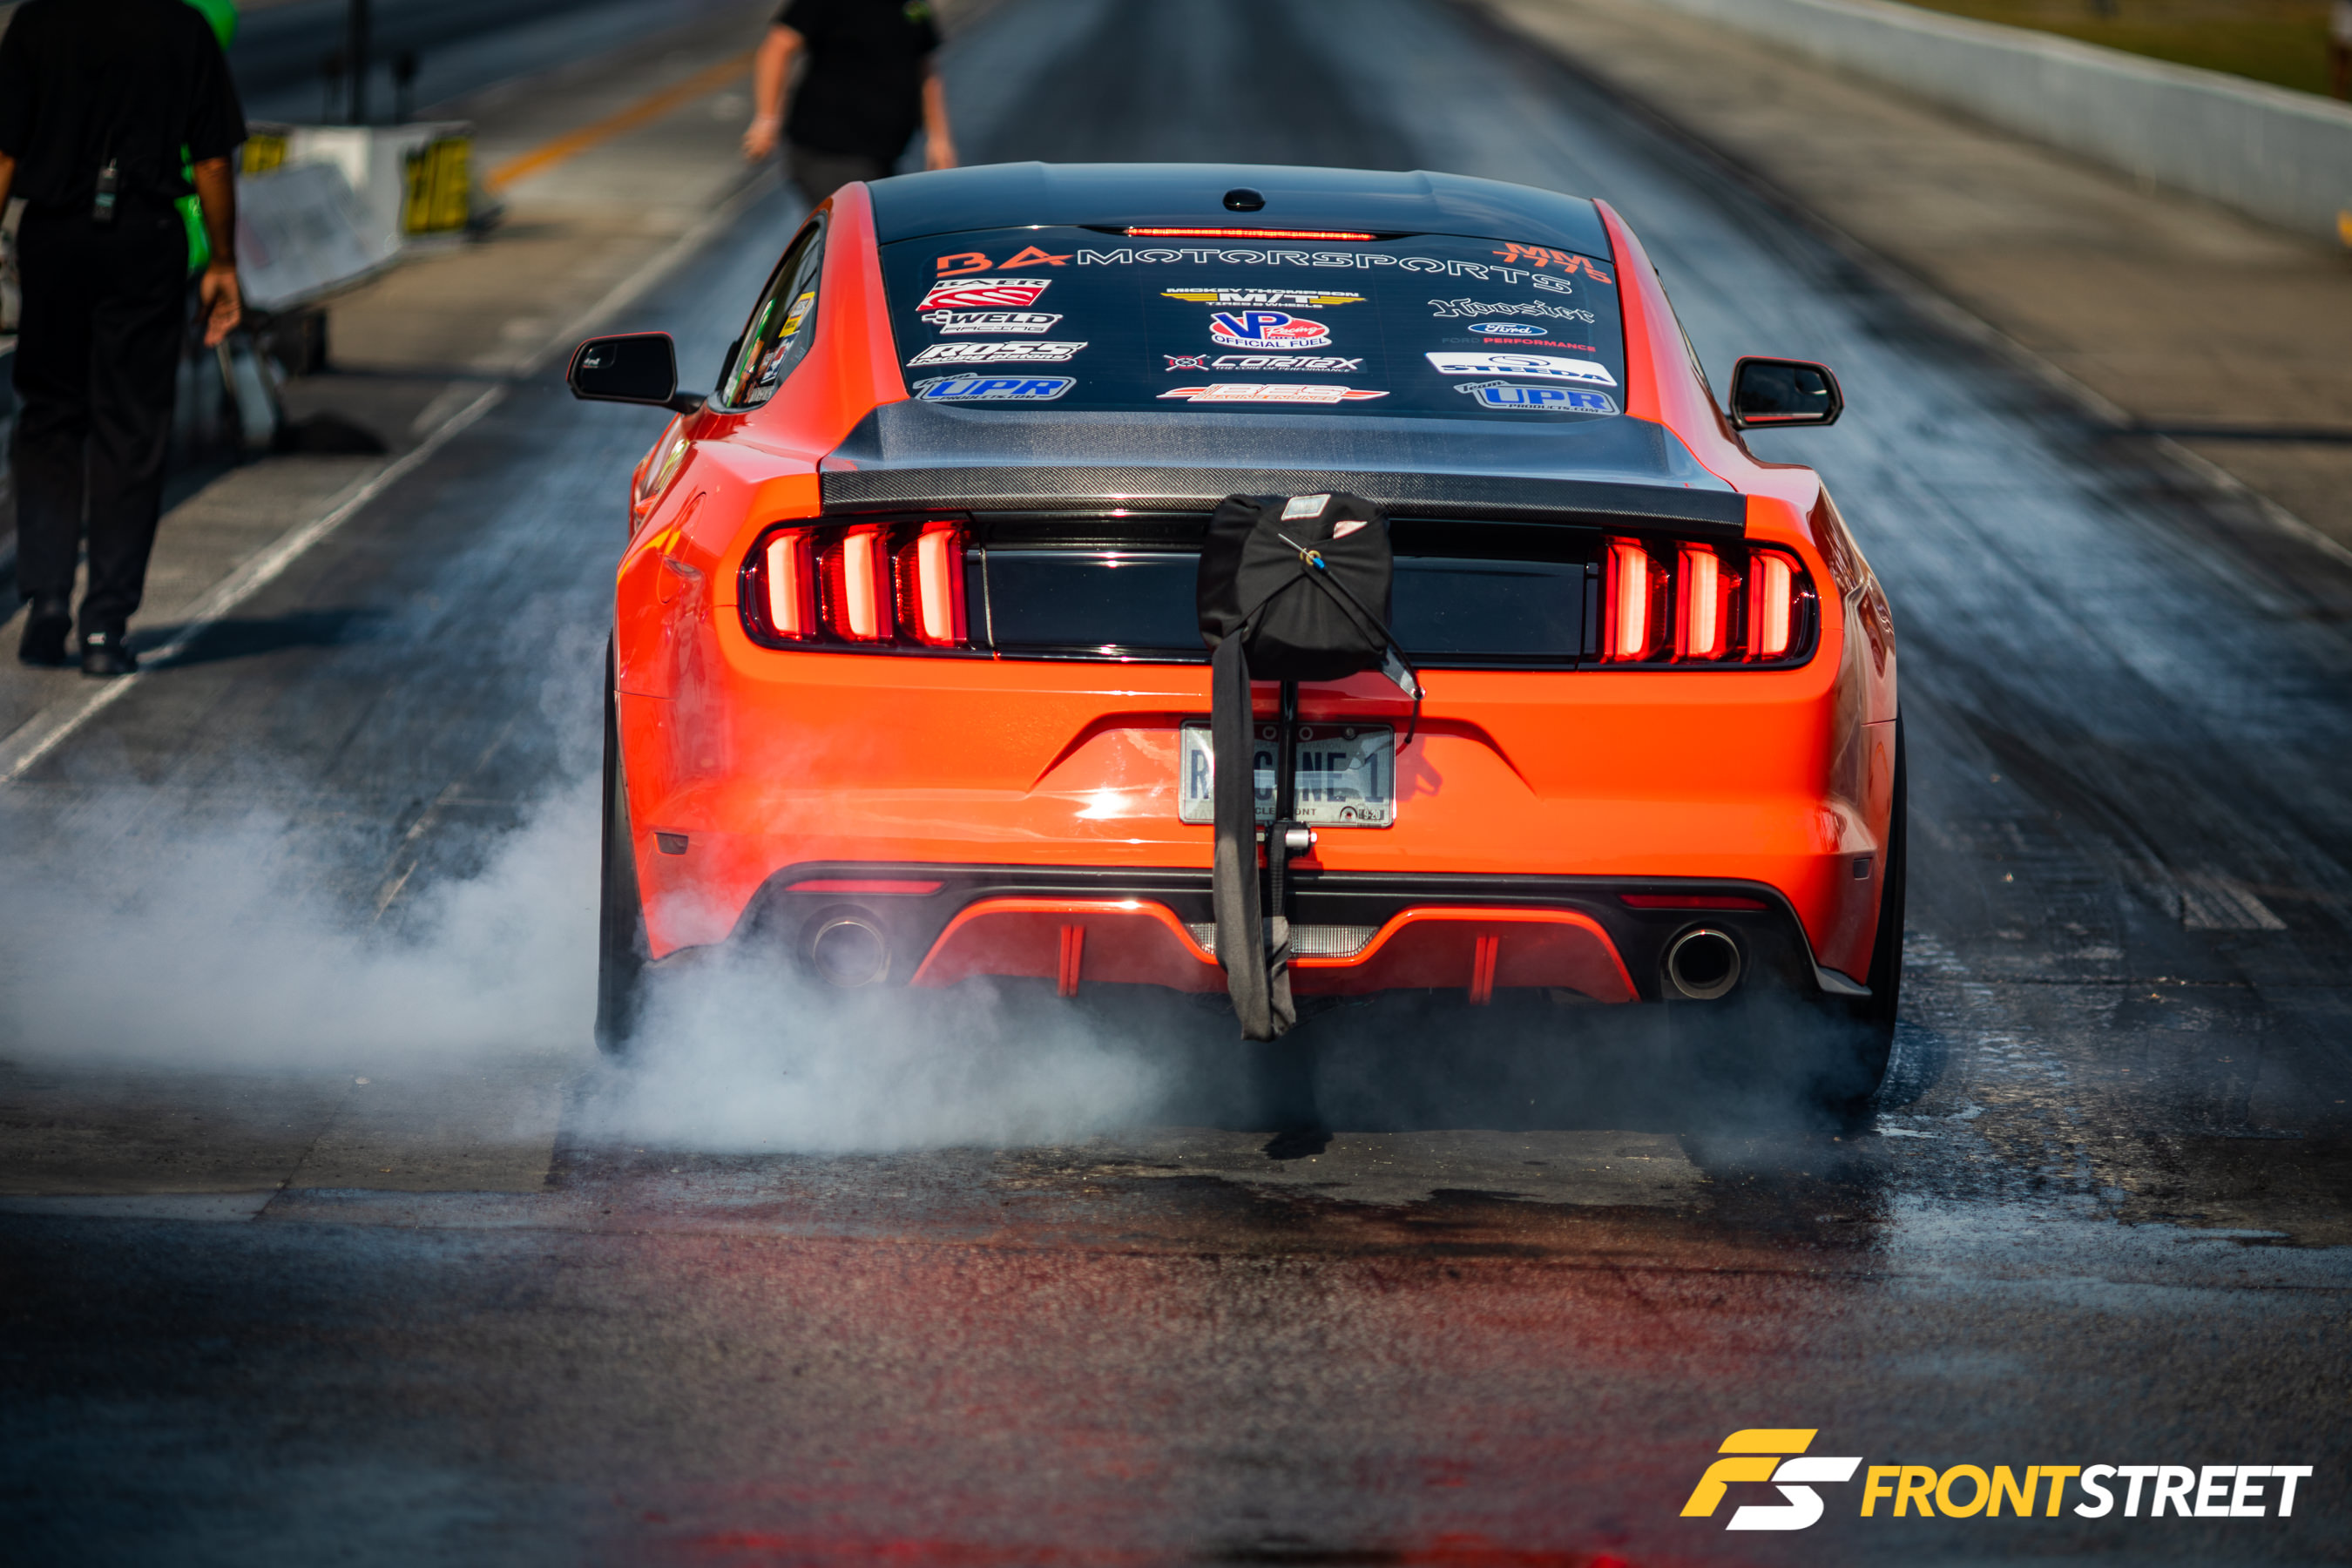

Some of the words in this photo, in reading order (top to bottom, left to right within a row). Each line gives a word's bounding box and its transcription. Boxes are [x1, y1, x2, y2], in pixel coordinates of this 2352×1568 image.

[1077, 248, 1572, 294] MOTORSPORTS
[935, 279, 1044, 288] BAER
[1219, 293, 1319, 304] M/T
[1245, 288, 1359, 297] THOMPSON
[1428, 298, 1595, 323] Hoosier
[950, 314, 1056, 324] WELD
[1212, 311, 1289, 340] VP
[1266, 326, 1323, 336] Racing
[1484, 325, 1532, 334] Ford
[1214, 335, 1285, 348] OFFICIAL
[1290, 337, 1327, 347] FUEL
[1484, 337, 1596, 352] PERFORMANCE
[1441, 364, 1609, 382] STEEDA
[927, 380, 1064, 396] UPR
[1463, 381, 1505, 391] Team
[1485, 389, 1608, 409] UPR
[1508, 404, 1599, 413] PRODUCTS.COM
